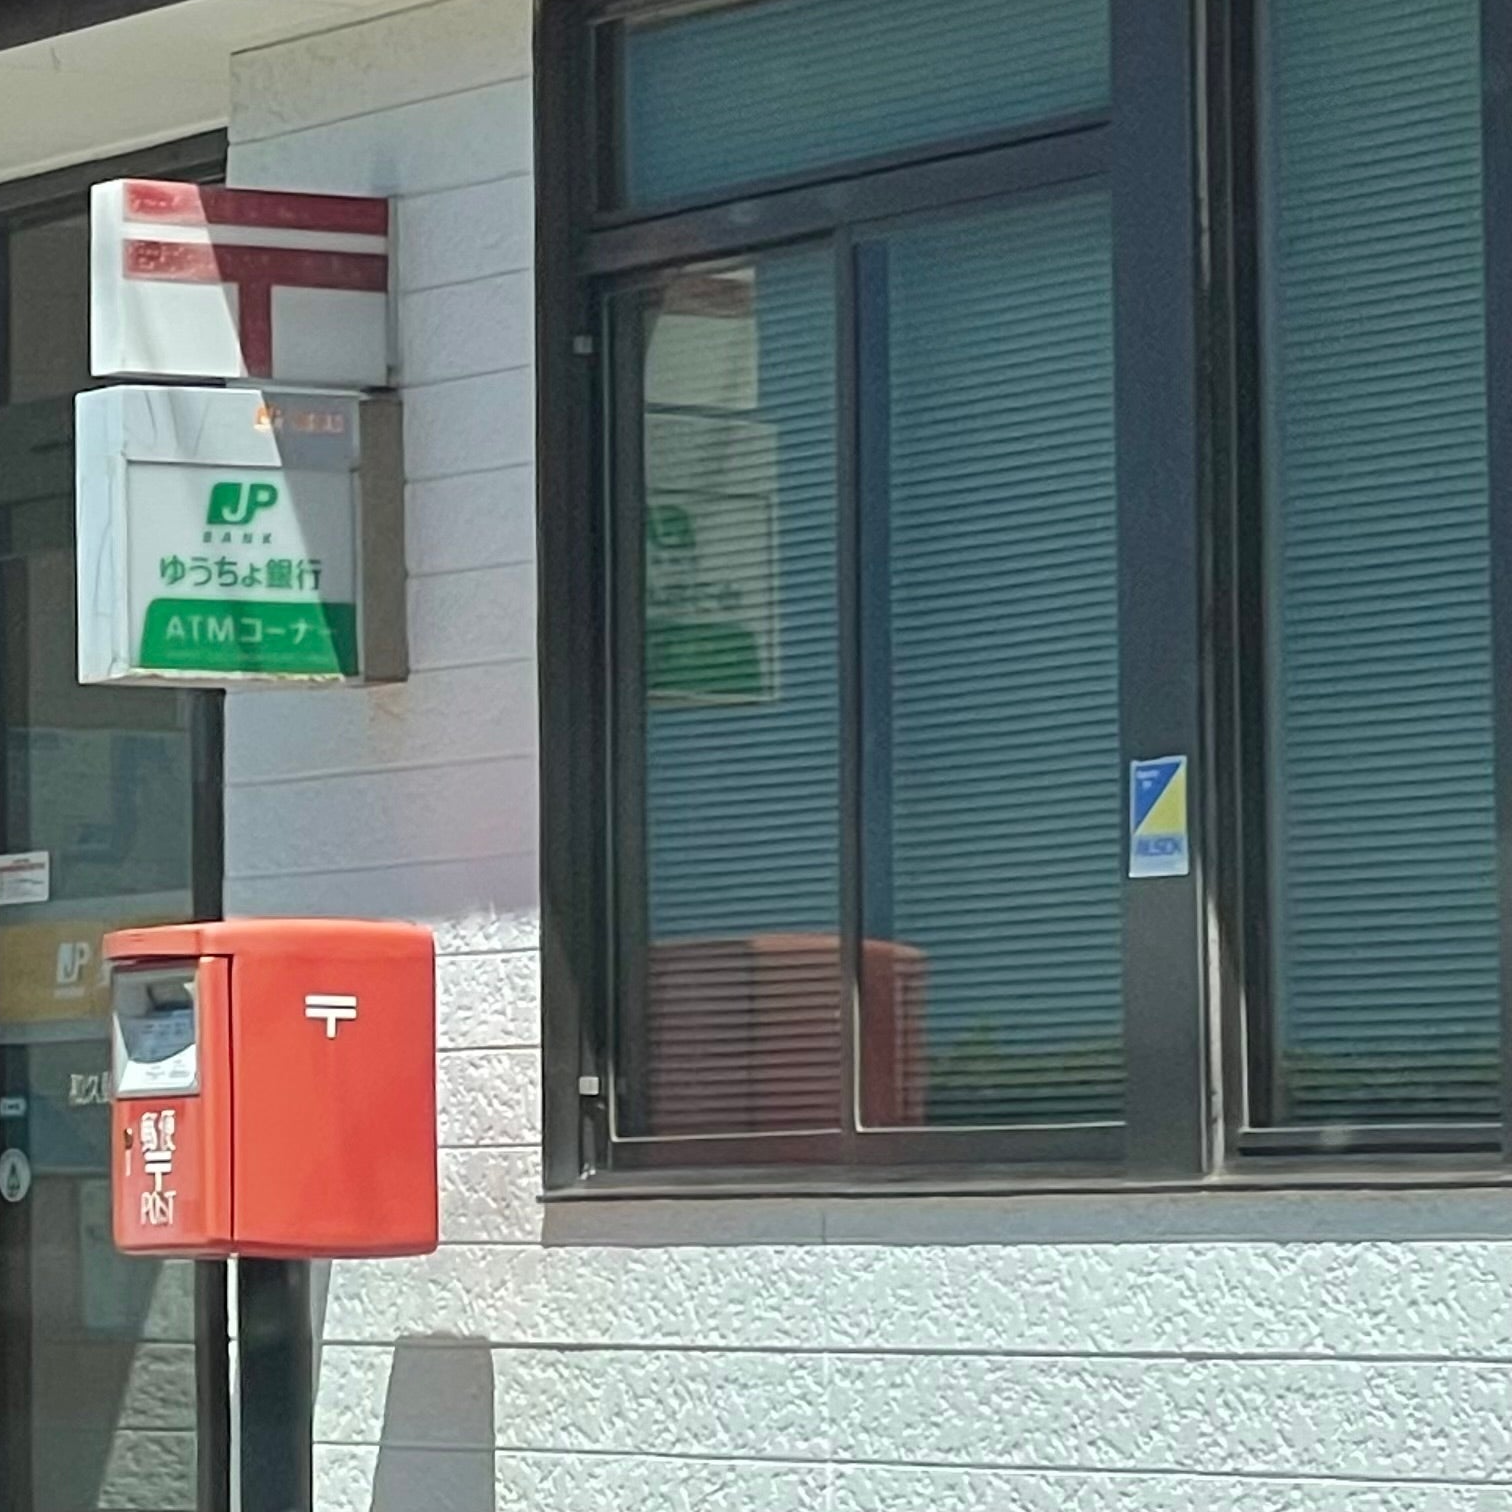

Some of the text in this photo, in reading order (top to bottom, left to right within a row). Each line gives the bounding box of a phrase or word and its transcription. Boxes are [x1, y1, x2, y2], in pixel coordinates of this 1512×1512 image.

[206, 482, 278, 525] JP
[202, 531, 272, 544] BANK
[159, 554, 322, 590] ゆうちょ銀行
[165, 615, 336, 645] ATMコーナー
[140, 1109, 176, 1152] 郵便
[140, 1190, 176, 1225] POST
